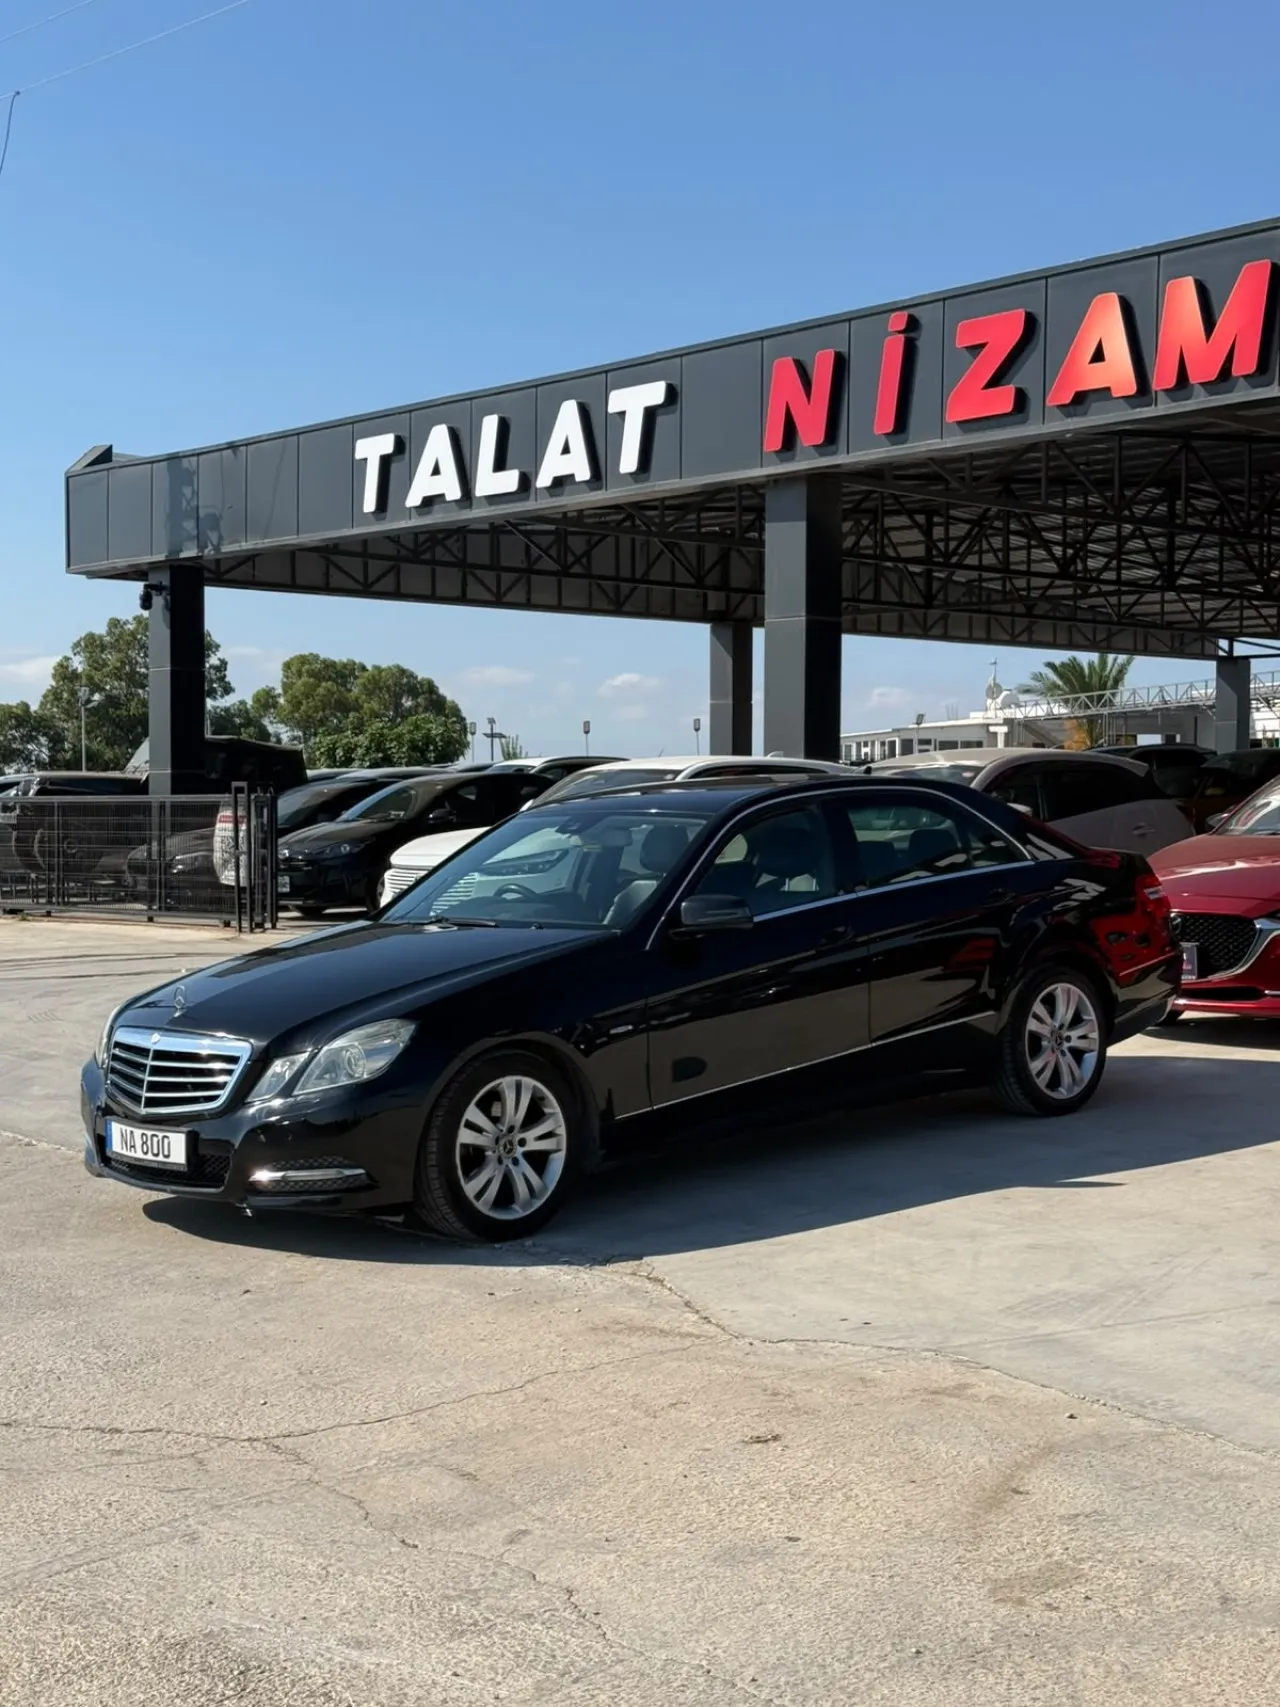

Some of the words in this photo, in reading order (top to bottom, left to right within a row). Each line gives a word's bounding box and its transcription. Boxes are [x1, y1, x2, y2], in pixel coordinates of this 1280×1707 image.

[354, 379, 668, 514] TALAT
[763, 259, 1273, 453] NİZAM
[120, 1127, 137, 1154] NA
[141, 1132, 171, 1159] 800
